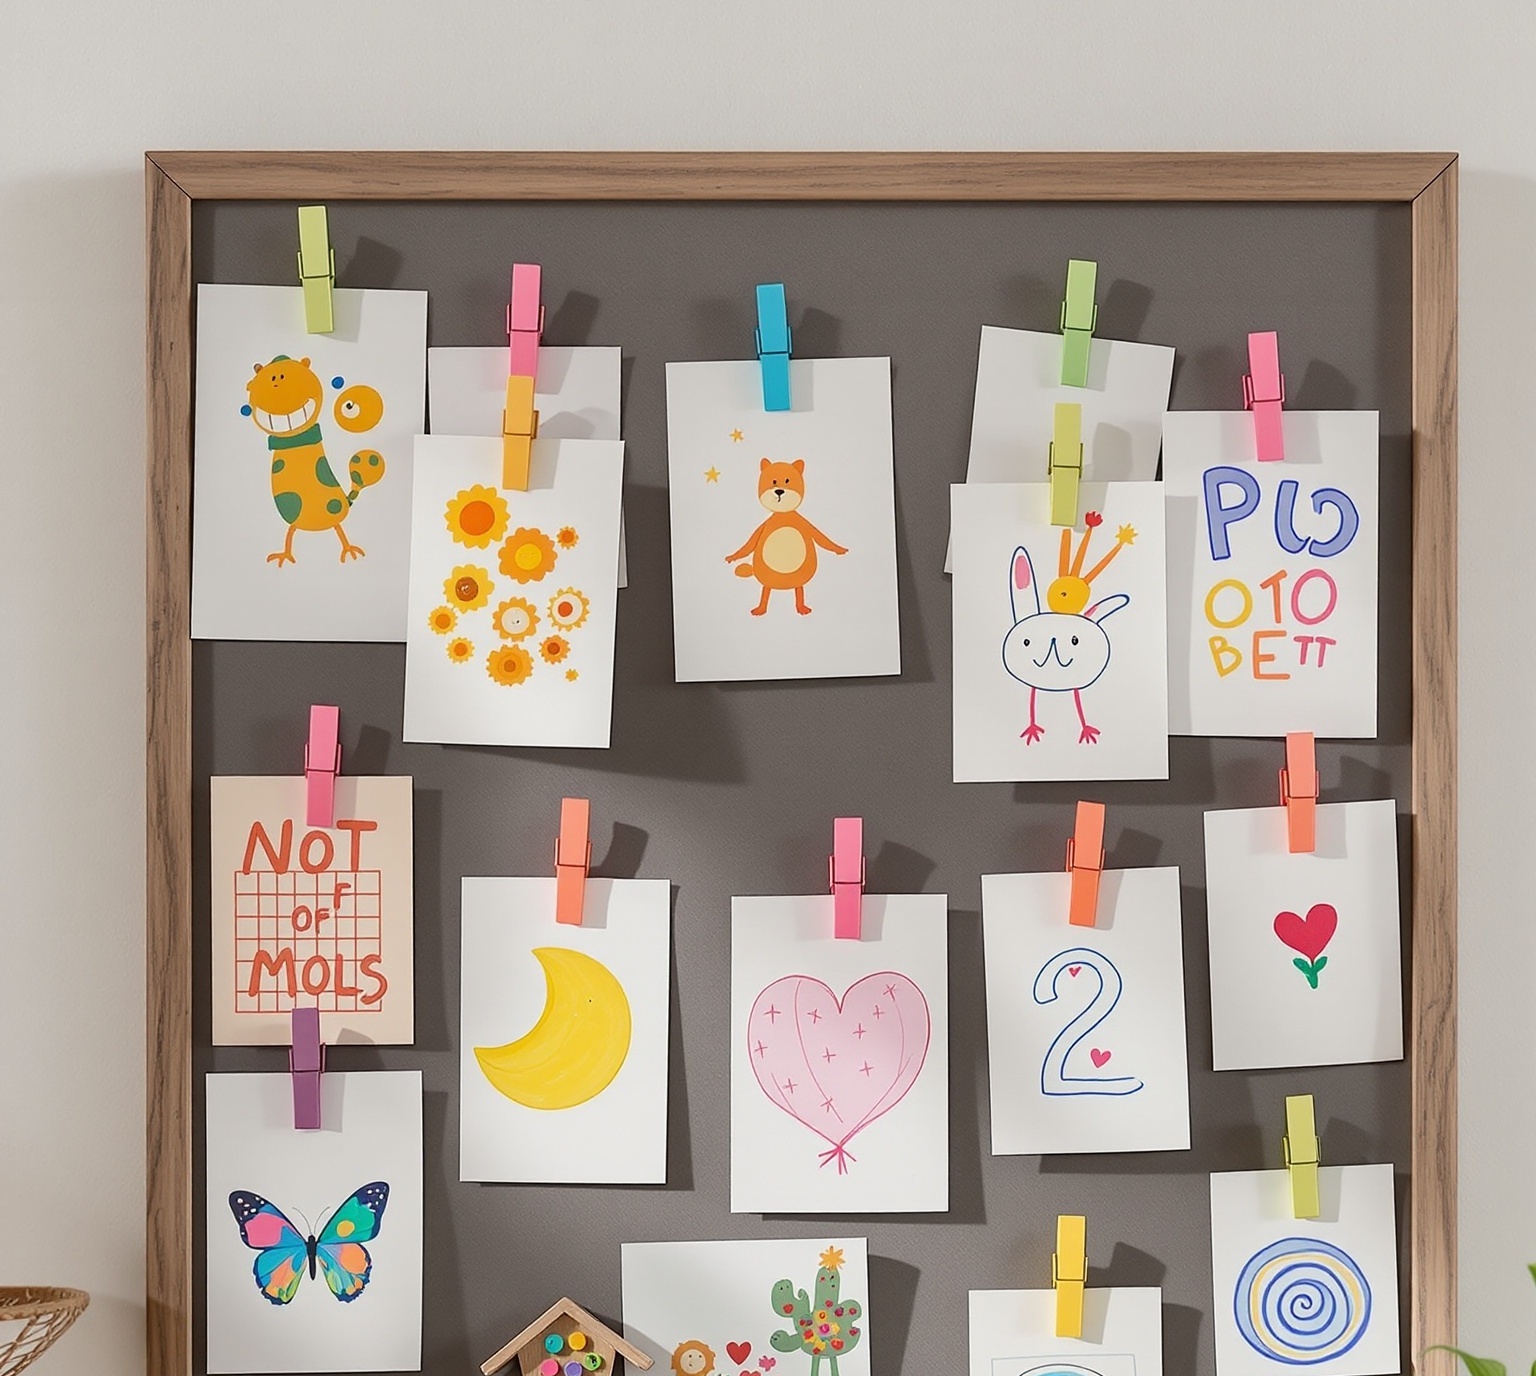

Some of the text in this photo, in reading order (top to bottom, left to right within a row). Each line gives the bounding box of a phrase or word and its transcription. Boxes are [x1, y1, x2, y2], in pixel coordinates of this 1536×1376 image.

[242, 819, 378, 875] NOT
[248, 947, 388, 1005] MOLS
[1033, 947, 1145, 1097] 2
